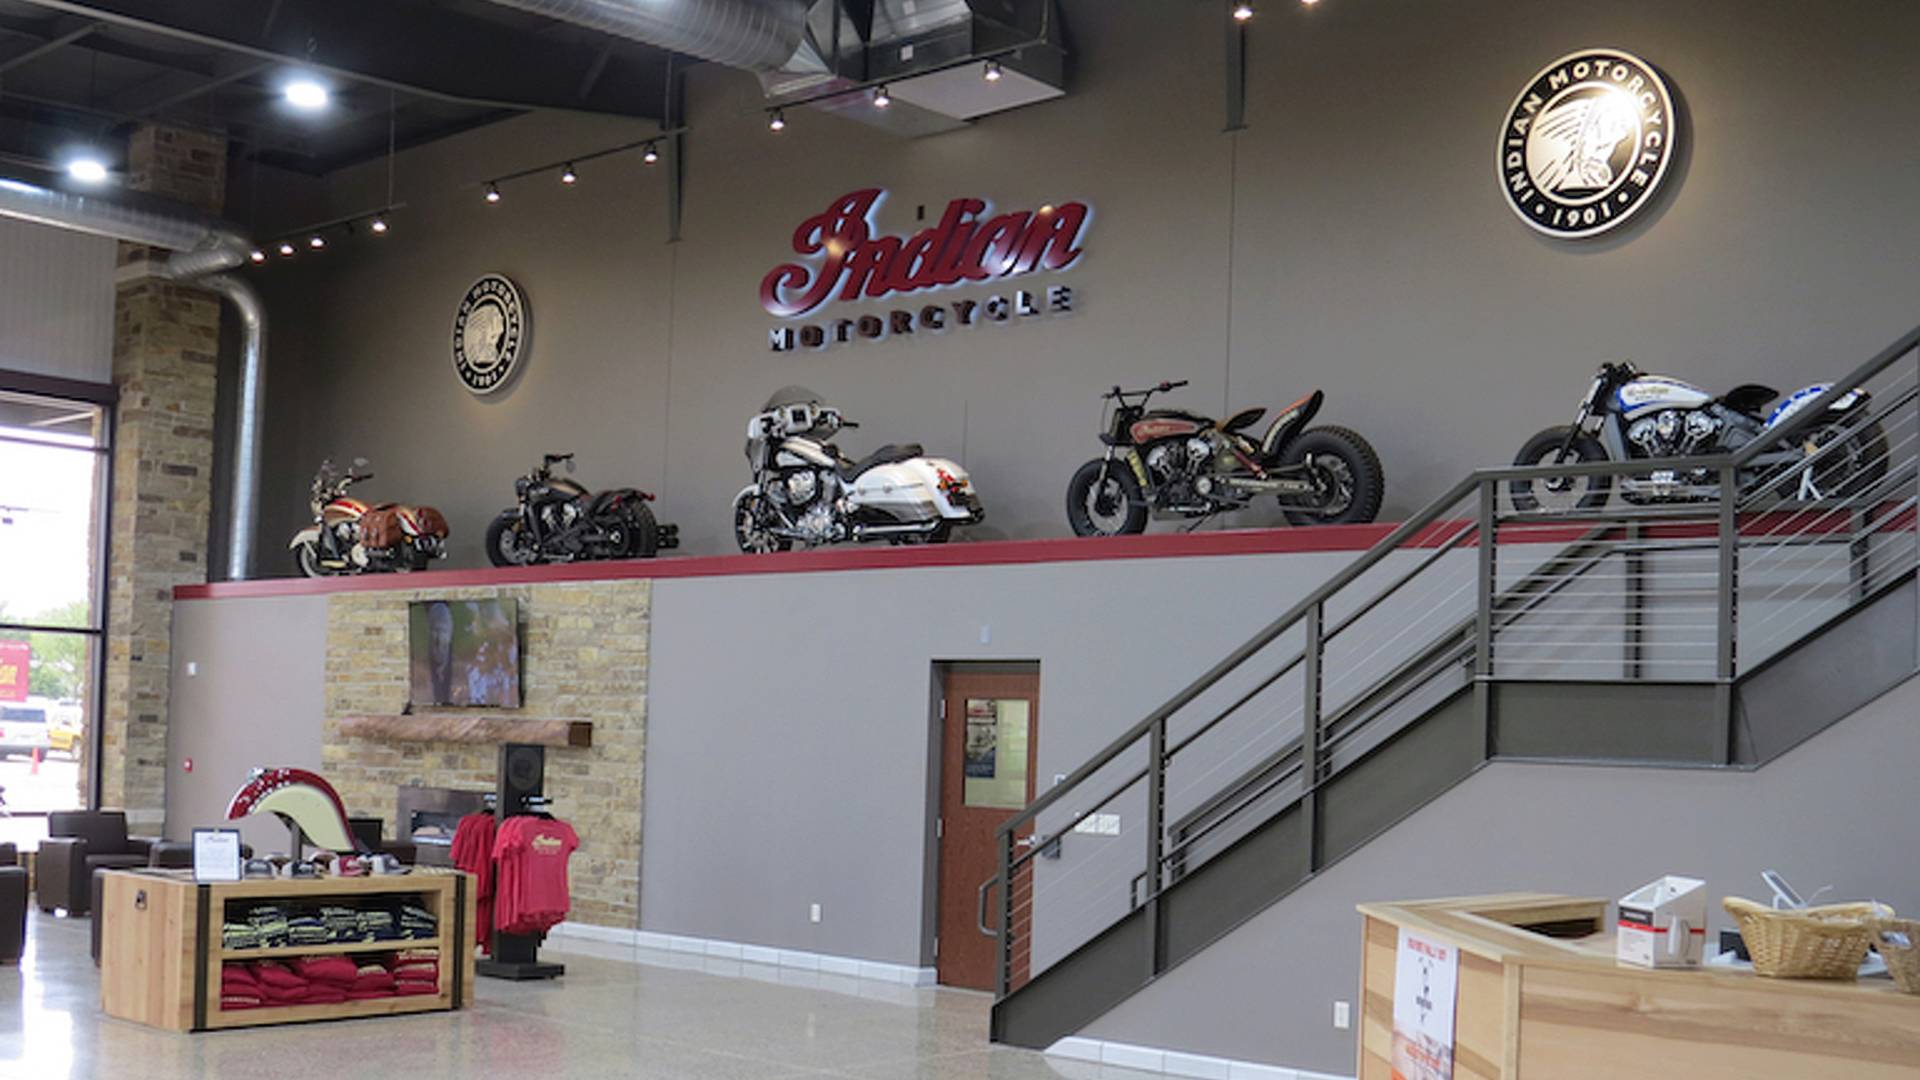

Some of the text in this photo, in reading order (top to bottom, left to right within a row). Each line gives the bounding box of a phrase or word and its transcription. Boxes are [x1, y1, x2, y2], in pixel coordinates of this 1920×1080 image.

[1507, 60, 1663, 203] INDIAN MOTORCYCLE
[760, 188, 1089, 317] Indian
[1553, 202, 1612, 226] 1901
[769, 286, 1074, 351] MOTORCYCLE
